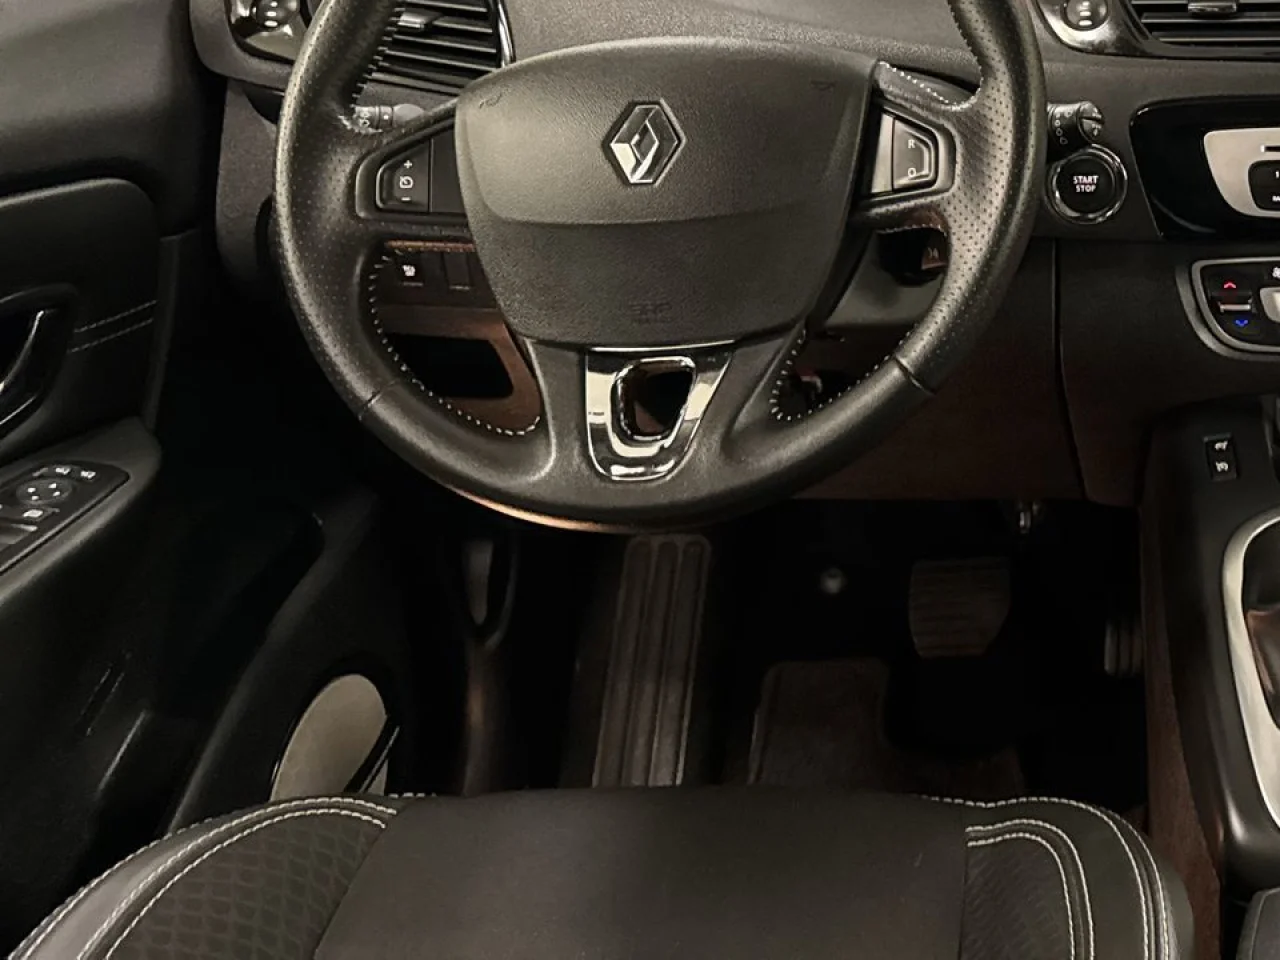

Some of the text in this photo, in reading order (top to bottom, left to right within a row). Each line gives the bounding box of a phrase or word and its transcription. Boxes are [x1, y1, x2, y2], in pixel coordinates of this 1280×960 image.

[908, 139, 915, 149] R
[1073, 175, 1099, 185] START
[1075, 185, 1097, 193] STOP
